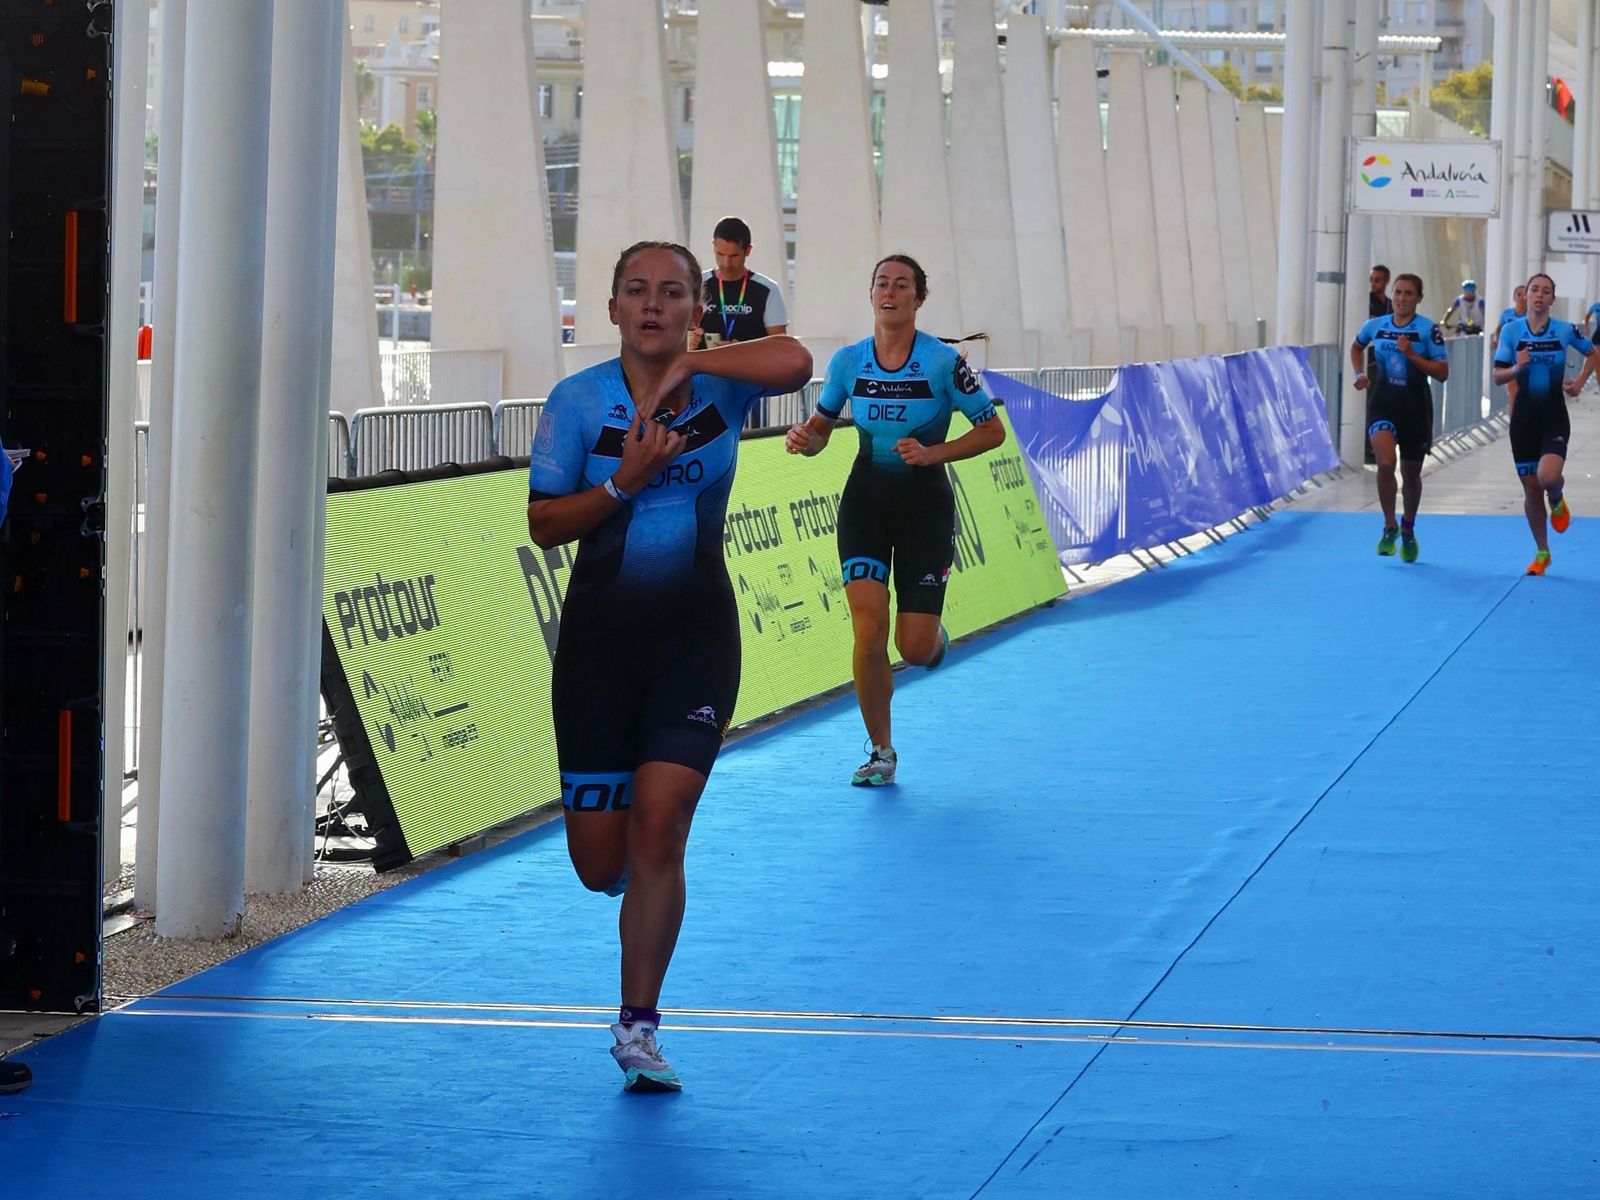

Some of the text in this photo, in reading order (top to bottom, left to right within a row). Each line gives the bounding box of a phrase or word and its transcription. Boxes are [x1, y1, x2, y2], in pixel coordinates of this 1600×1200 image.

[1401, 160, 1489, 184] Andalucía
[868, 404, 907, 422] DIEZ
[989, 452, 1025, 492] protour
[334, 572, 441, 649] protour
